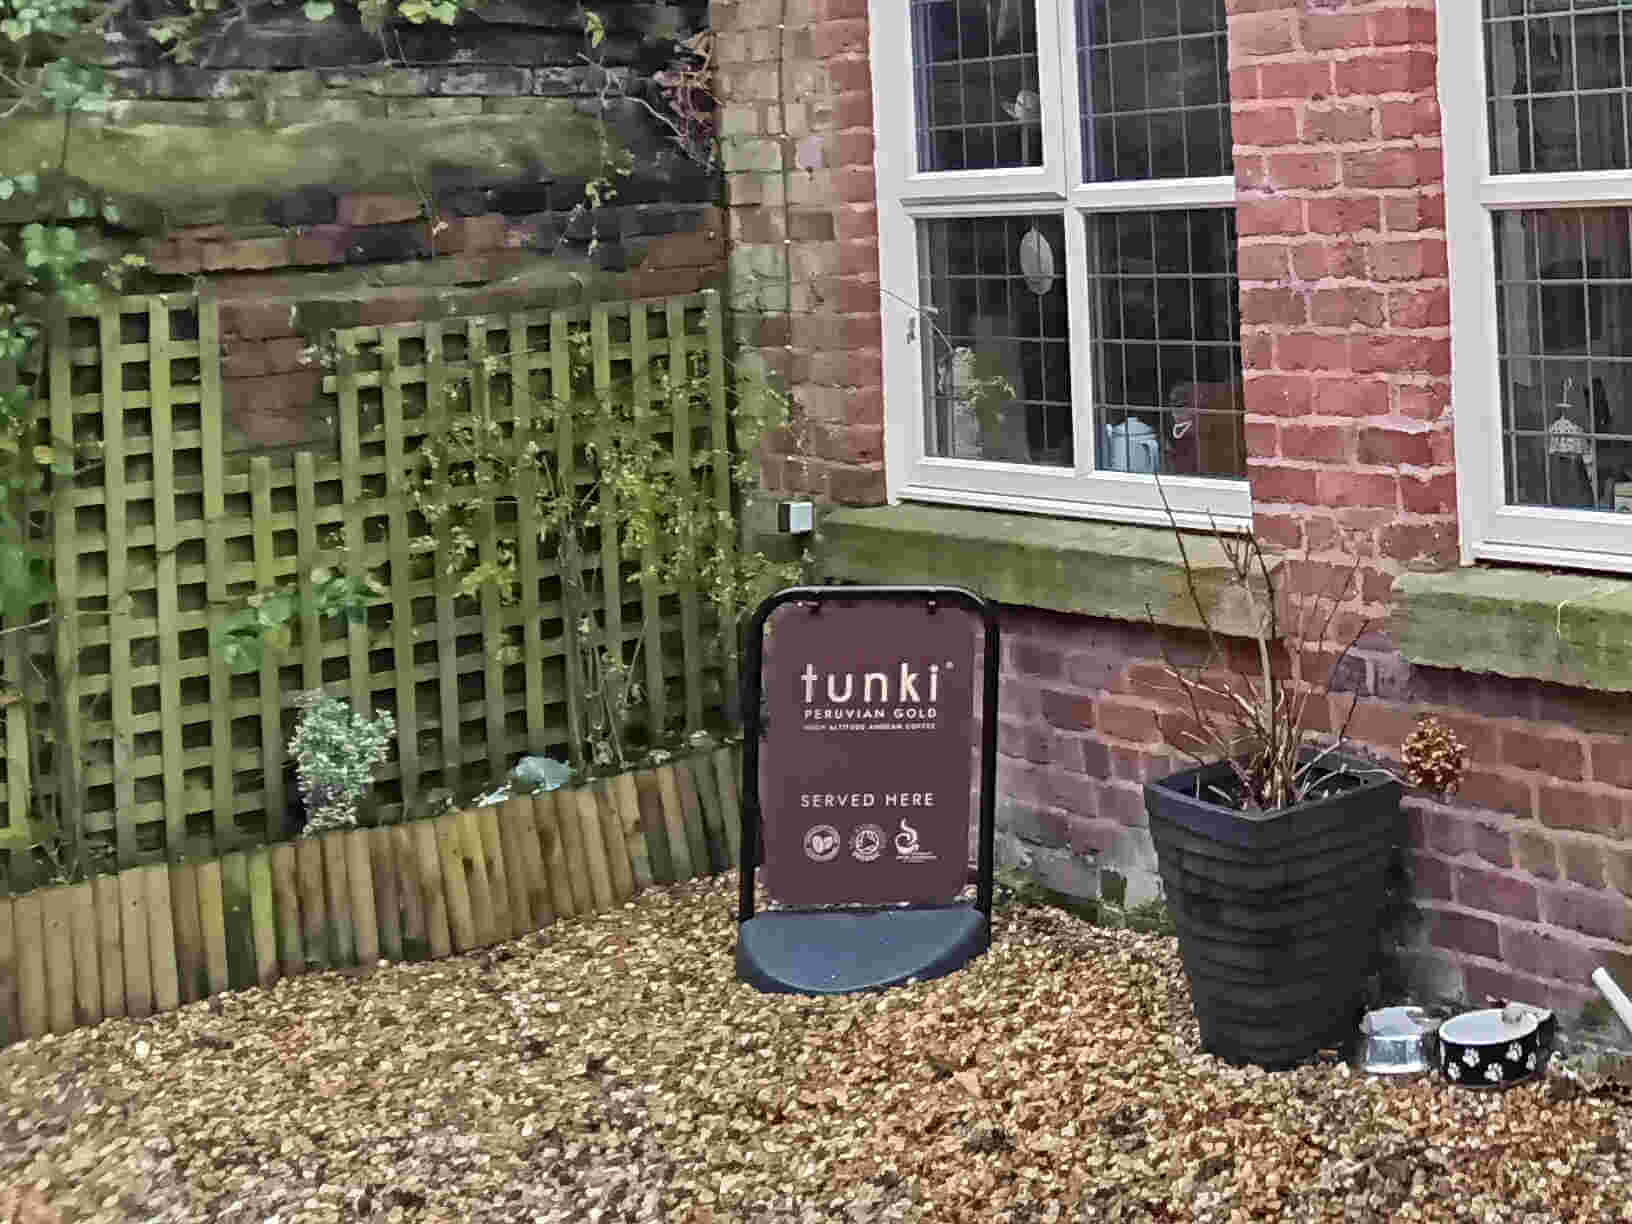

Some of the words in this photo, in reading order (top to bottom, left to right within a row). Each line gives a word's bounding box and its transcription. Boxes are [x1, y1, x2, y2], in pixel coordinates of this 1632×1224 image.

[801, 662, 939, 704] tunki
[804, 708, 886, 720] PERUVIAN
[893, 707, 938, 720] GOLD
[800, 793, 876, 808] SERVED
[885, 792, 936, 807] HERE
